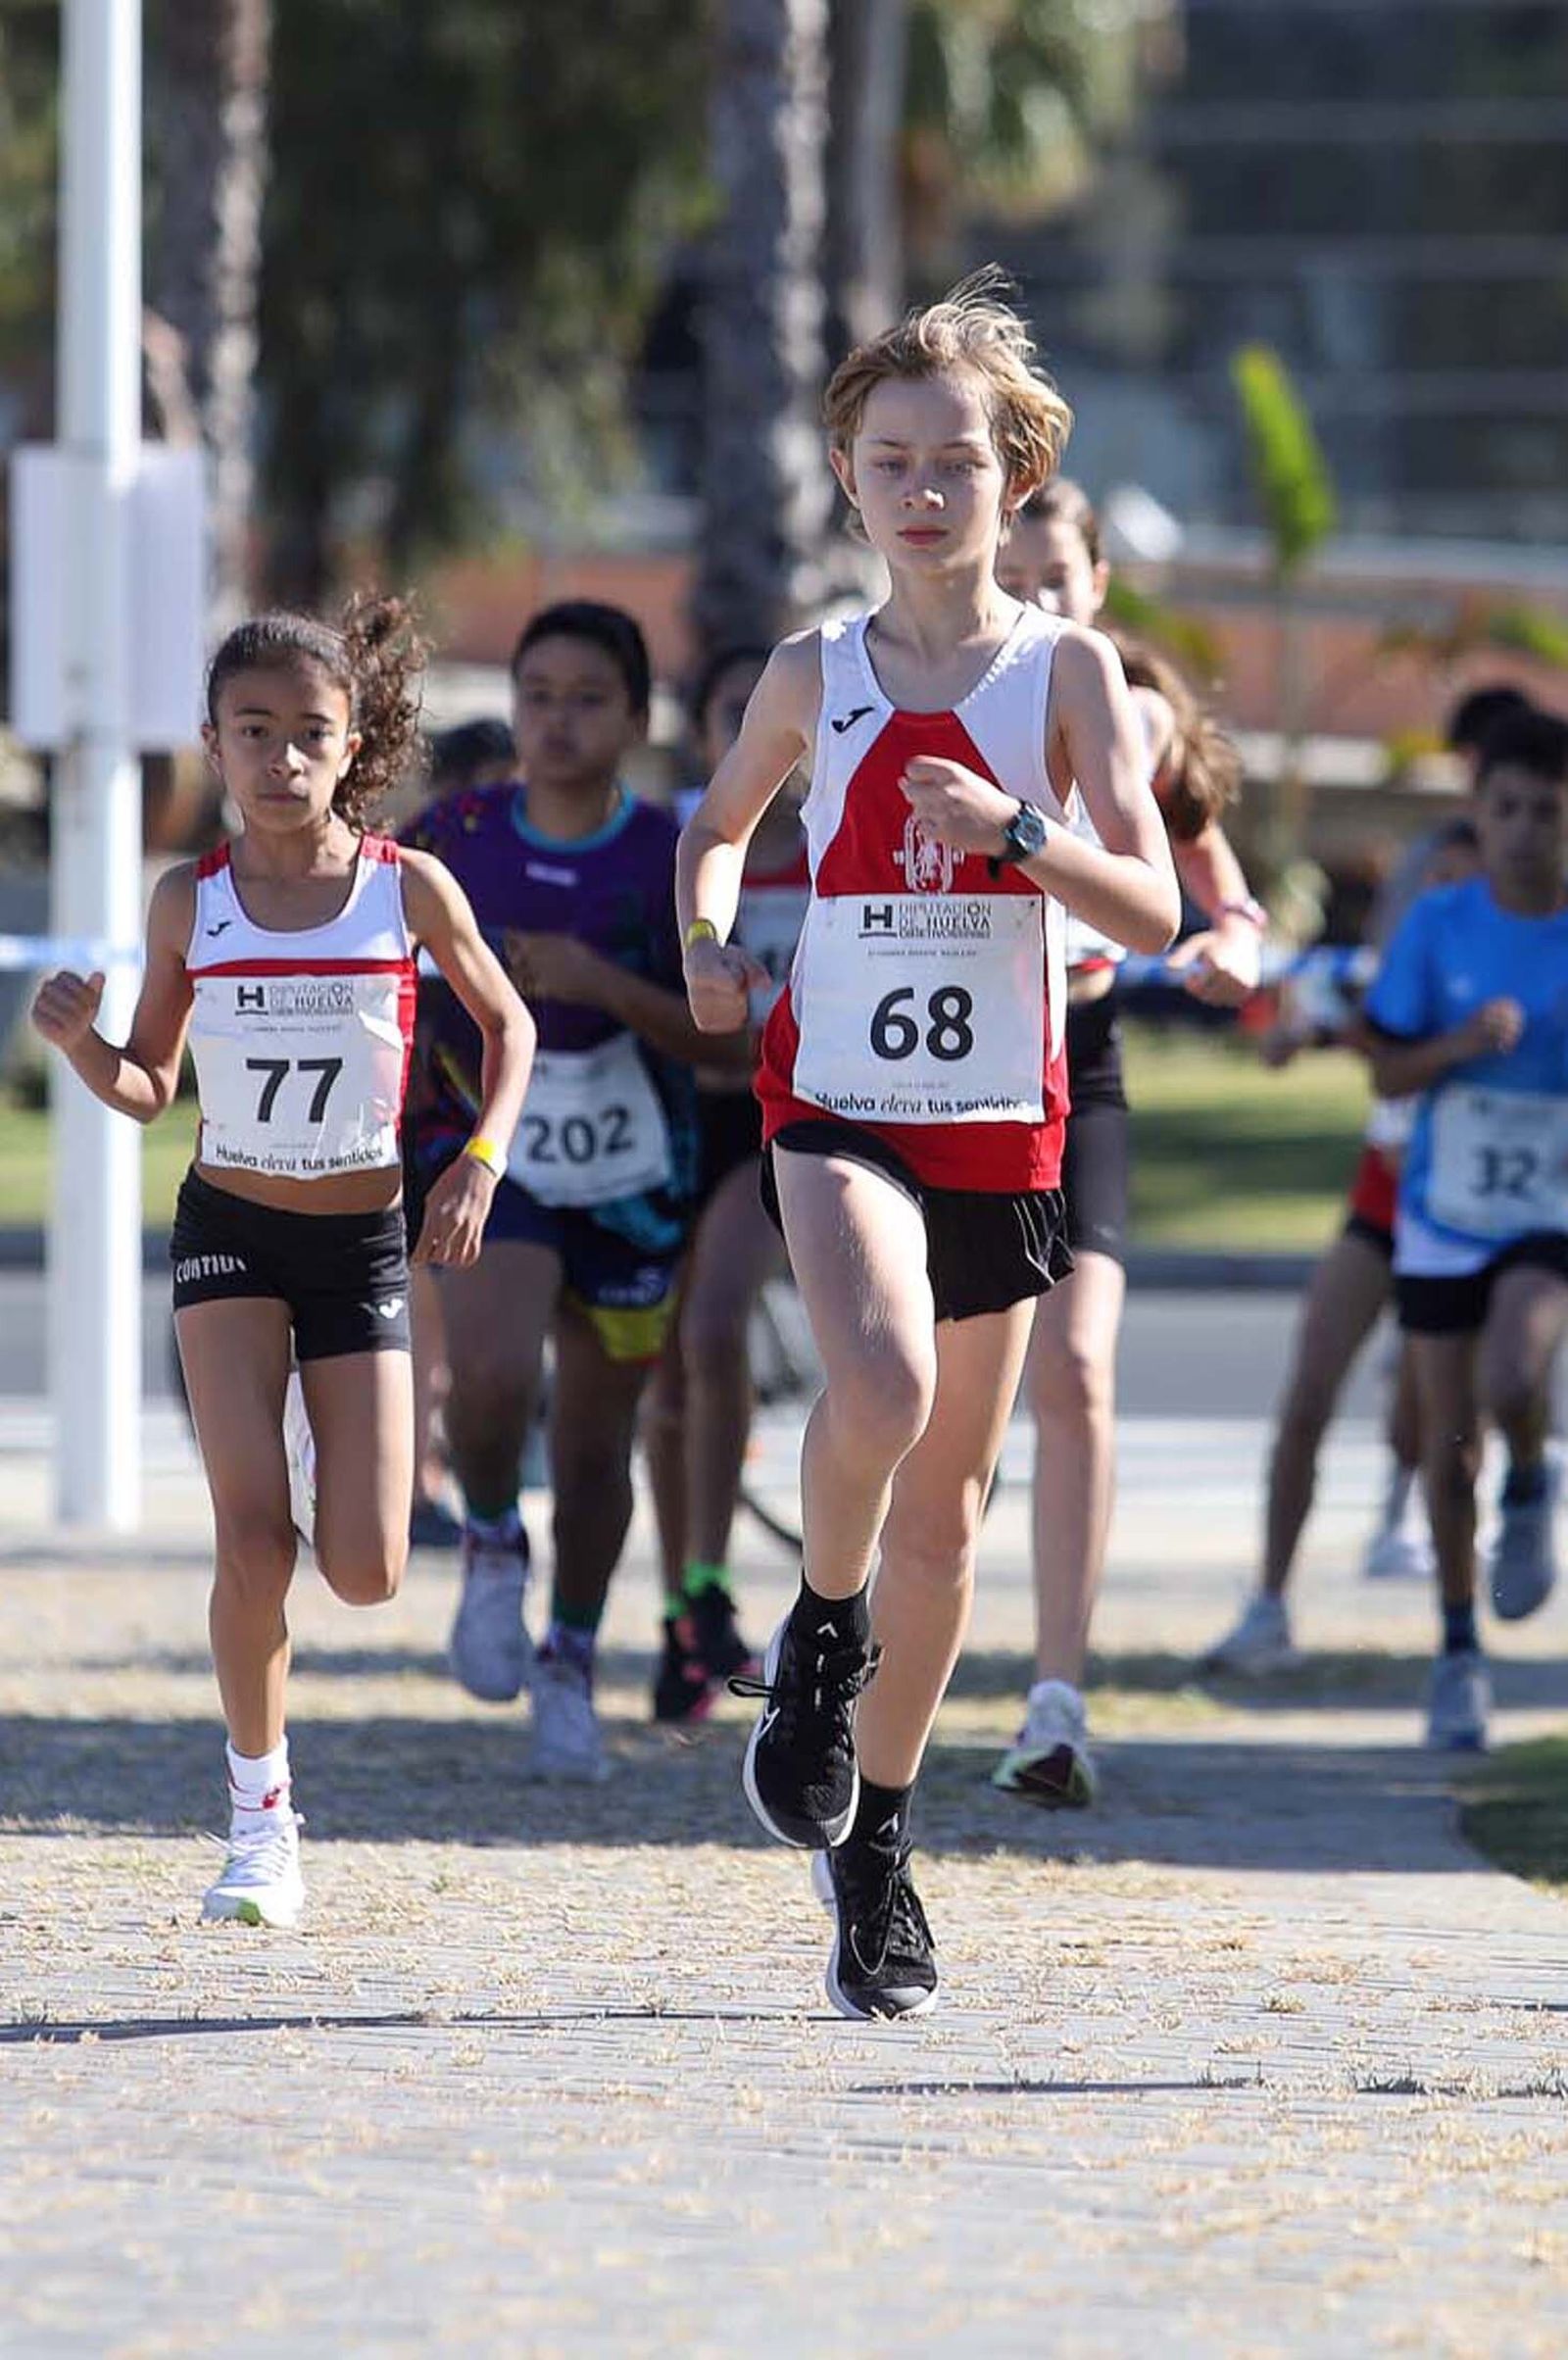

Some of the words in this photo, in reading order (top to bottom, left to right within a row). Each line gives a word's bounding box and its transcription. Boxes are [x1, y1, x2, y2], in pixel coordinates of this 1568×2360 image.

[870, 985, 974, 1061] 68
[246, 1057, 344, 1124] 77
[815, 1092, 876, 1112] Huelva
[927, 1097, 954, 1113] tus
[216, 1143, 257, 1167] Huelva
[302, 1157, 325, 1171] tus
[522, 1105, 635, 1164] 202
